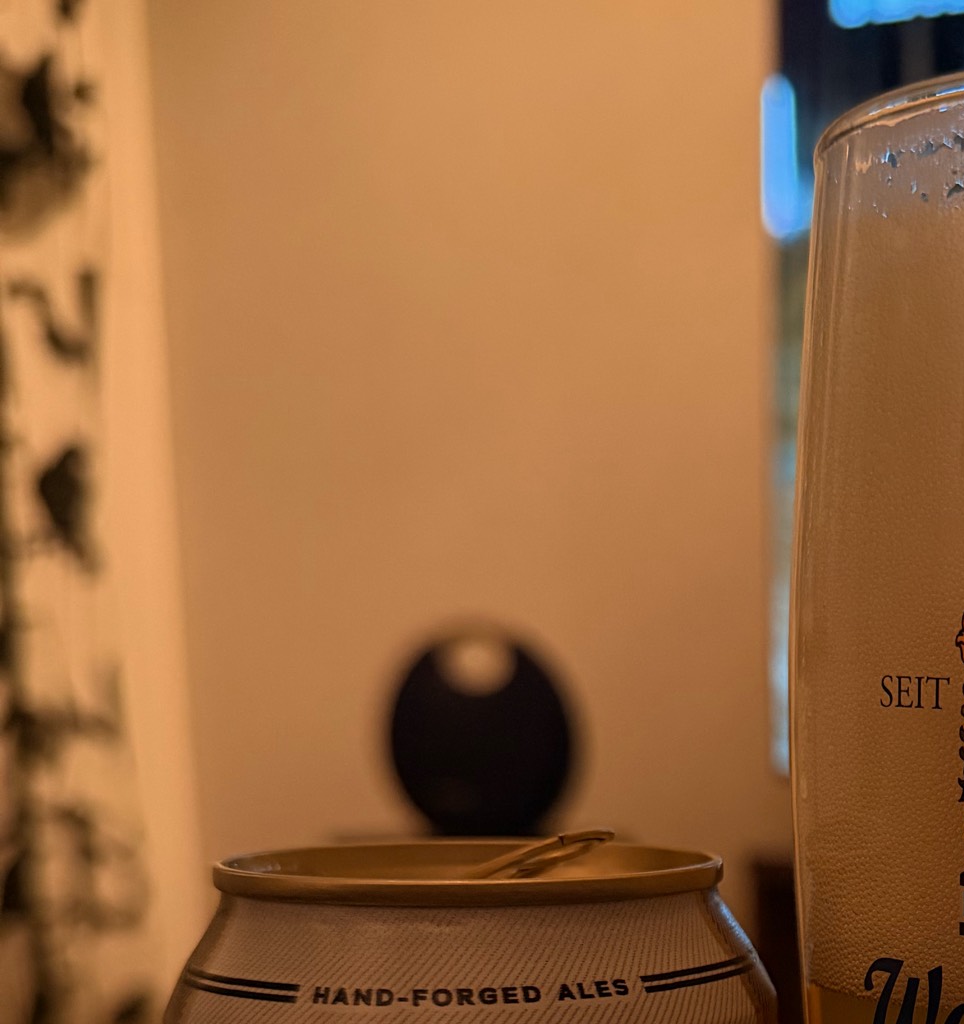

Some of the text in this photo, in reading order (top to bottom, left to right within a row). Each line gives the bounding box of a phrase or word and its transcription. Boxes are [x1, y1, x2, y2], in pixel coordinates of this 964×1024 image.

[880, 675, 950, 710] SEIT
[312, 979, 630, 1008] HAND-FORGED ALES
